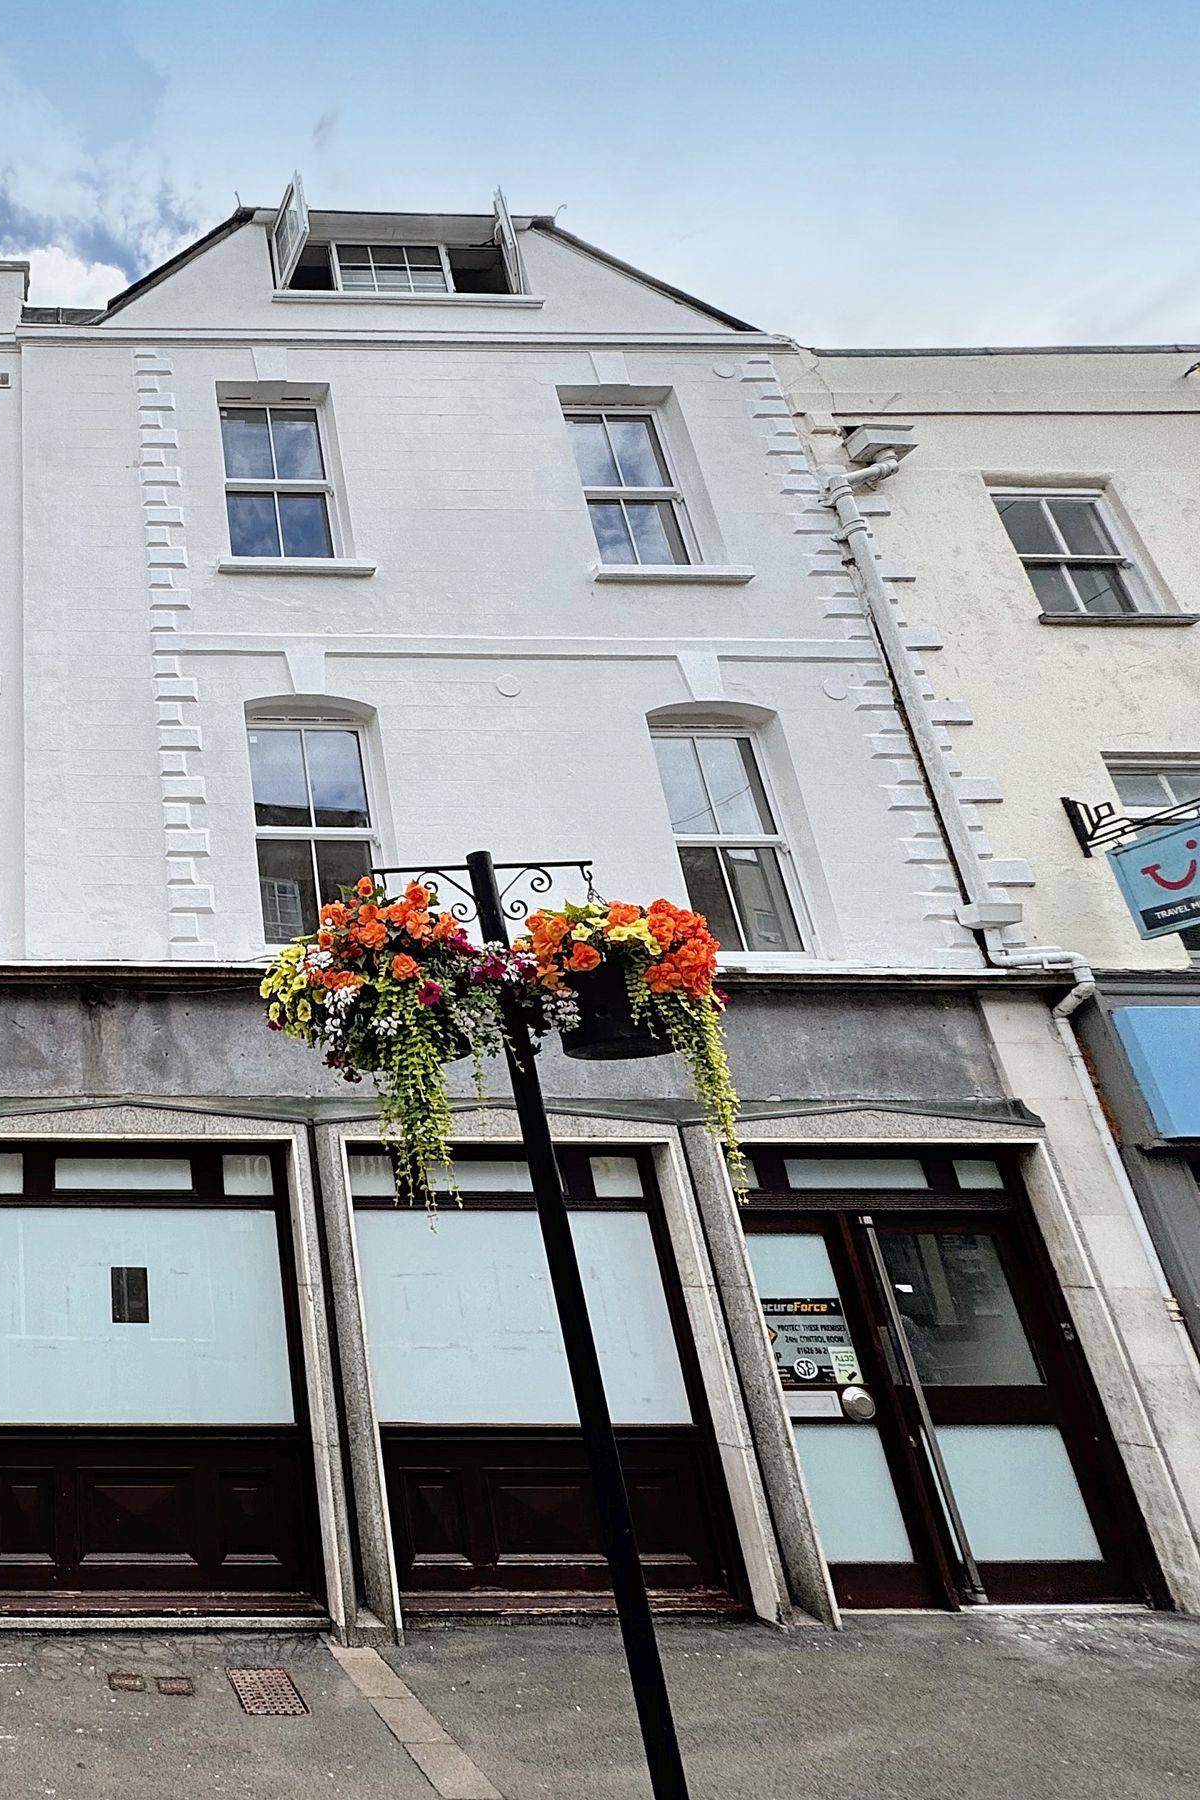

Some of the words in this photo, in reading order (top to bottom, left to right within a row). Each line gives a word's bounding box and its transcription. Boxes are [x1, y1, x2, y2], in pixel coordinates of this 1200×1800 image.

[1154, 905, 1191, 919] TRAVEL
[826, 1335, 844, 1343] ROOM
[835, 1355, 854, 1363] CCTV
